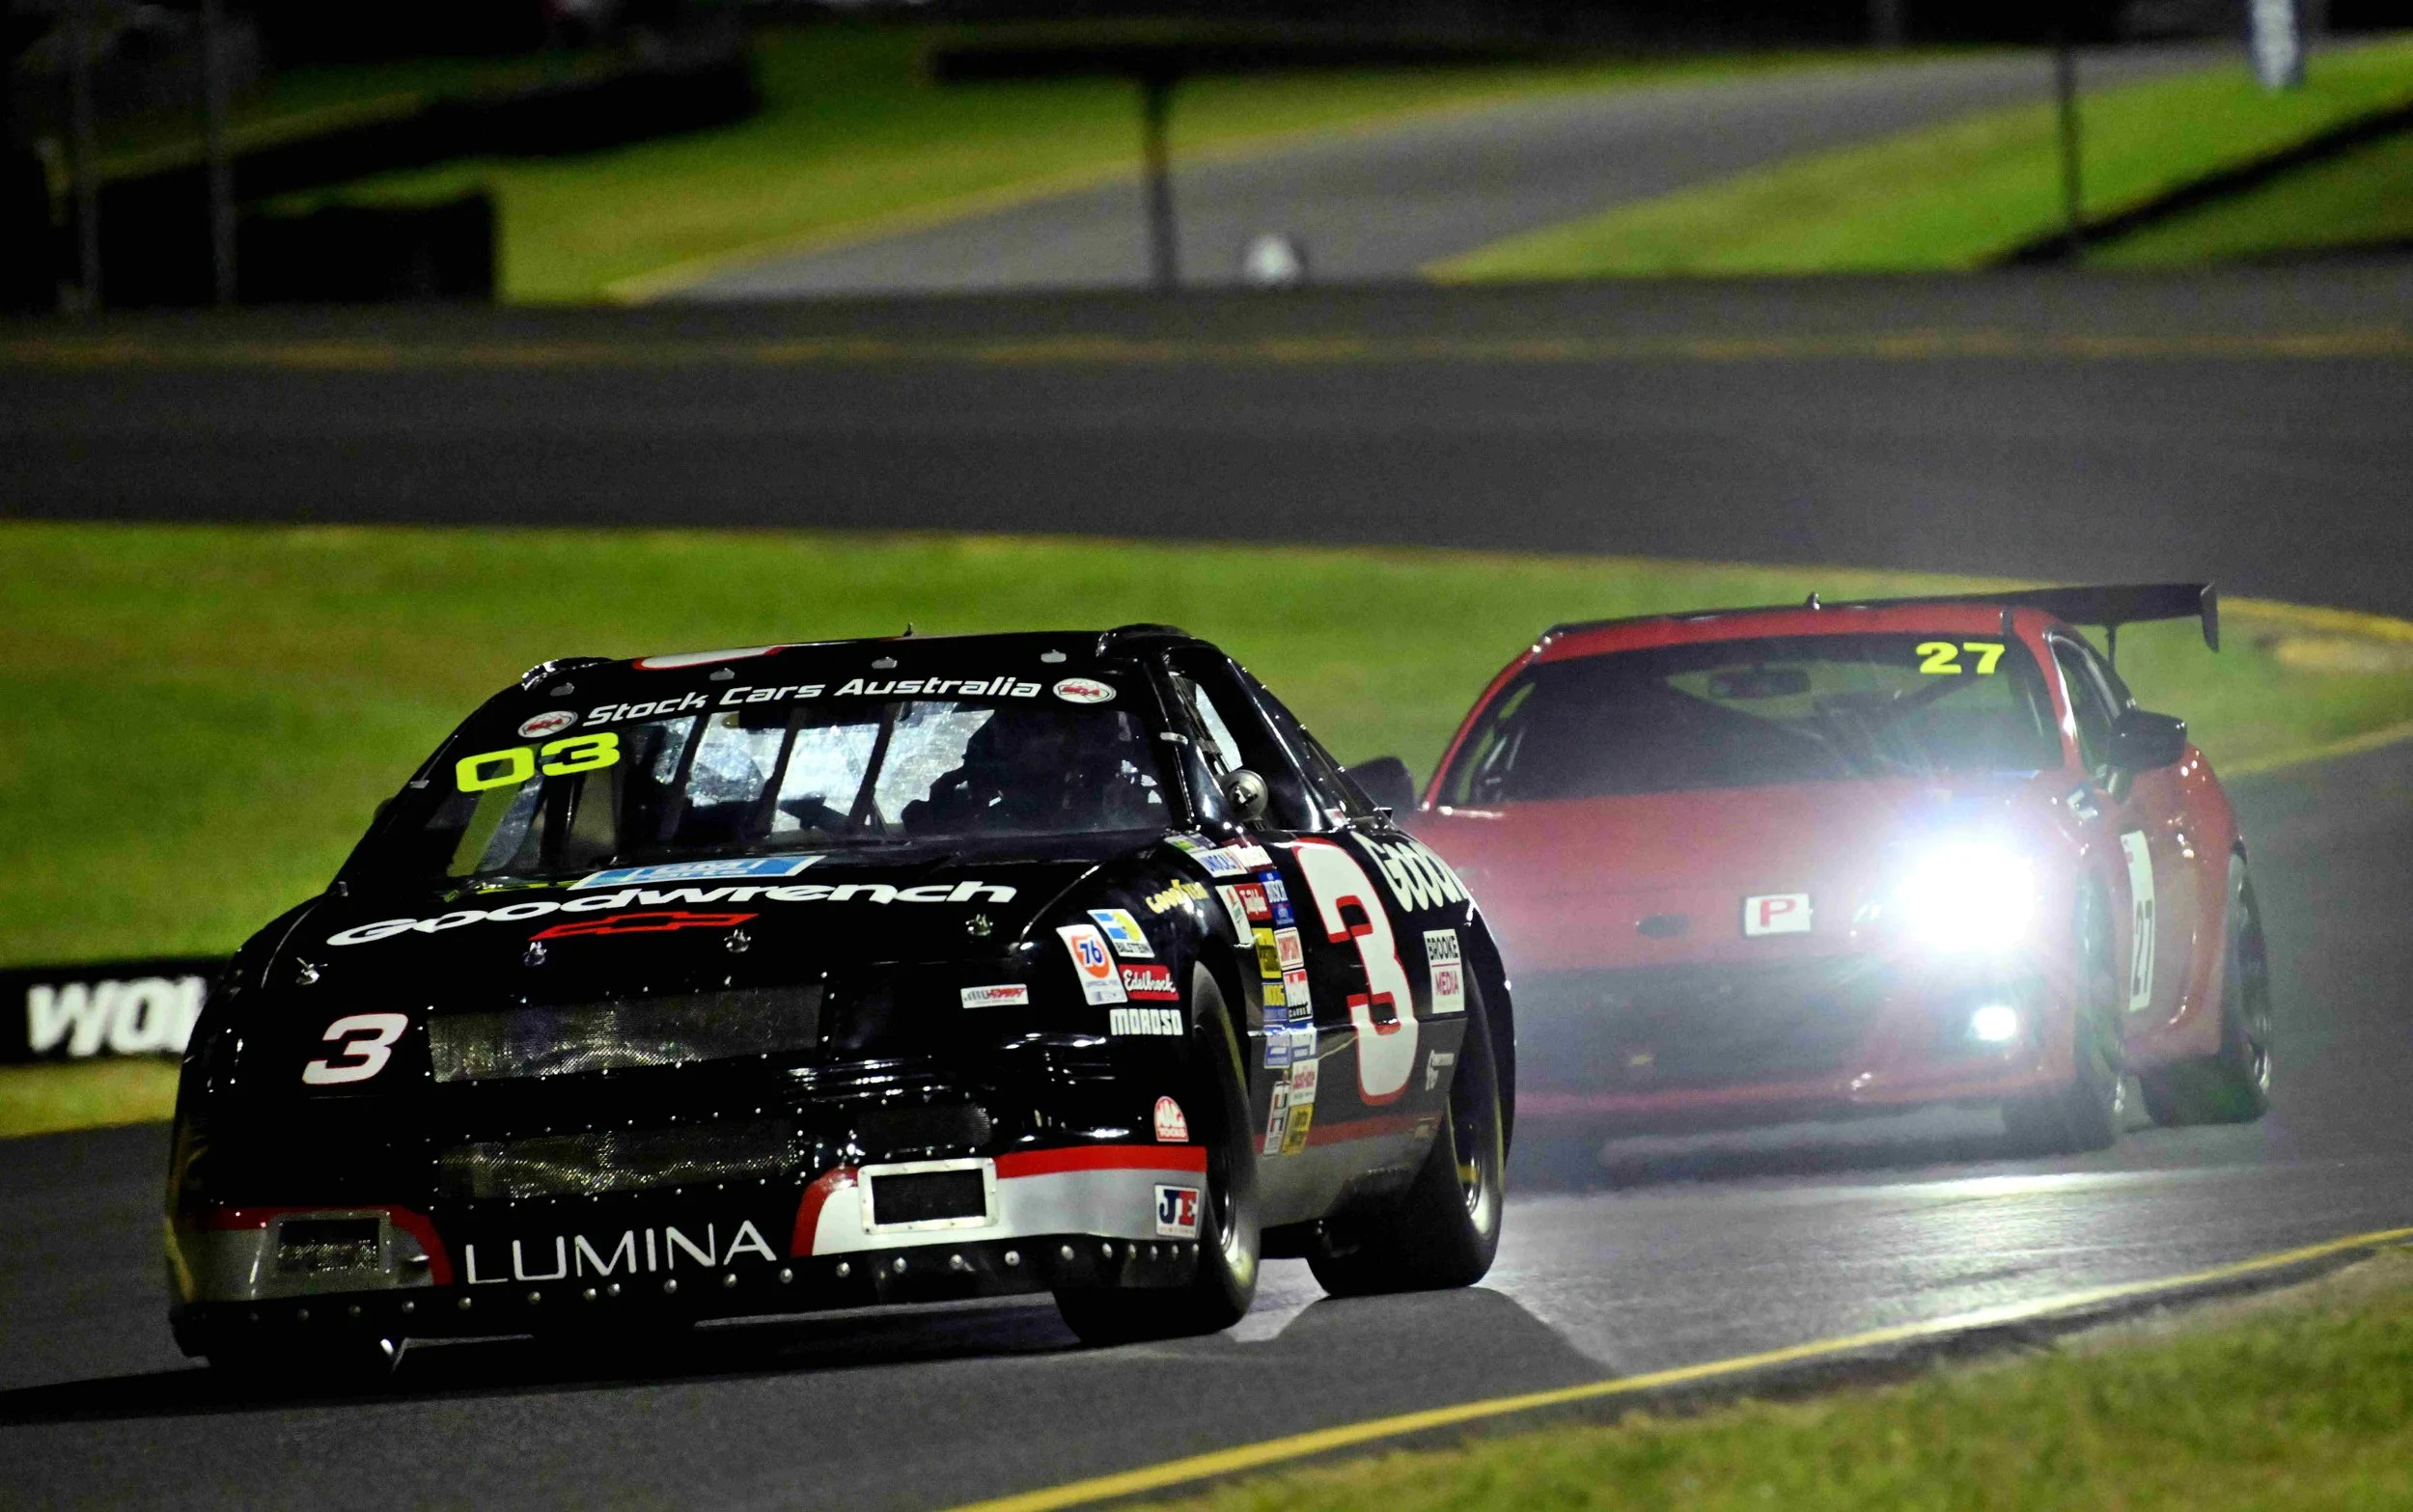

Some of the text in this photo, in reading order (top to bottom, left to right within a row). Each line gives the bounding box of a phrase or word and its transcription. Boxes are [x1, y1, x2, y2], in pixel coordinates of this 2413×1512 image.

[1915, 642, 2005, 675] 27
[582, 691, 709, 727] Stock
[719, 684, 826, 706] Cars
[833, 675, 1042, 698] Australia
[455, 731, 621, 793] 03
[326, 881, 1017, 947] Goodwrench
[1761, 897, 1796, 927] P
[1079, 940, 1103, 965] 76
[1427, 935, 1459, 961] BROOKE
[1123, 968, 1177, 993] Edelbrock
[1291, 837, 1419, 1106] 3
[1434, 970, 1459, 997] MEDIA
[1109, 1007, 1184, 1036] MOROSO
[301, 1012, 409, 1085] 3
[1159, 1188, 1198, 1226] JE
[465, 1220, 778, 1285] LUMINA
